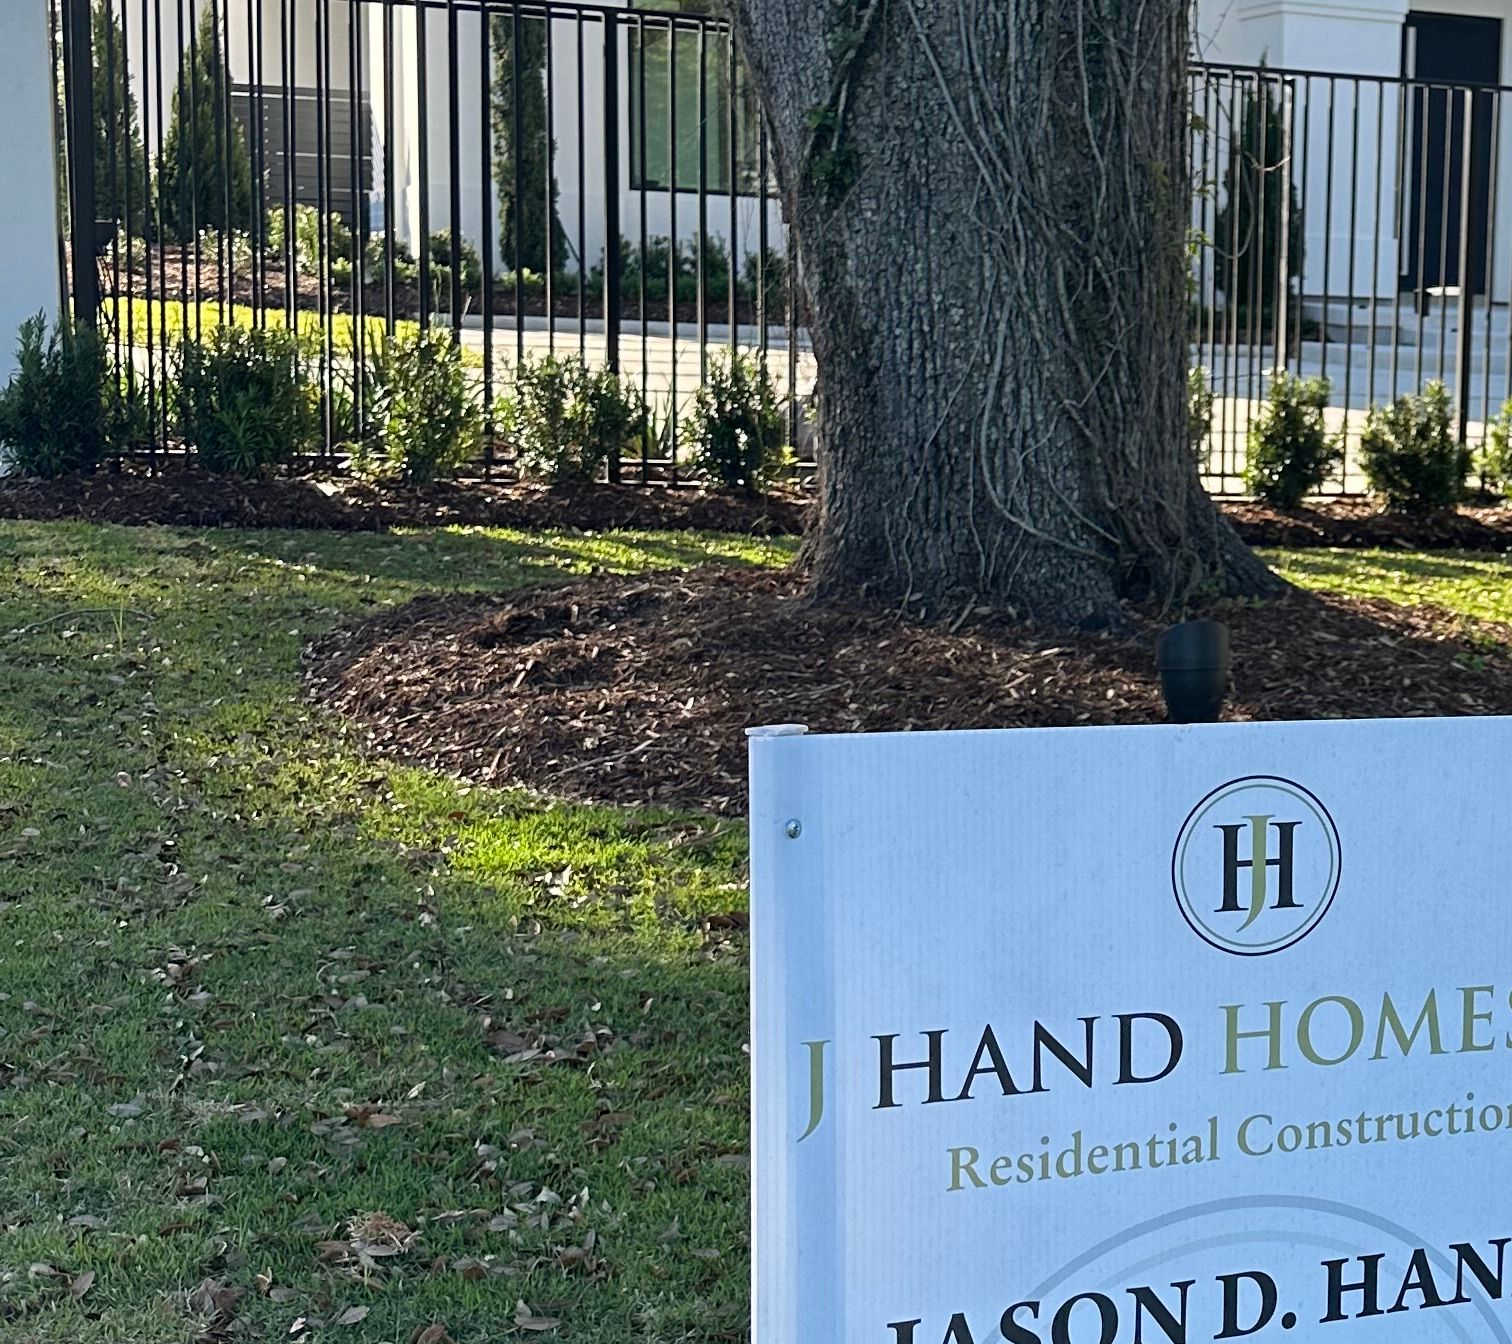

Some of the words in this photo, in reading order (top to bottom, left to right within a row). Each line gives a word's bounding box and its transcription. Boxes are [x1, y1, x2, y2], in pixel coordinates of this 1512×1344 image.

[798, 1039, 832, 1142] J
[871, 1012, 1184, 1109] HAND
[946, 1116, 1220, 1192] Residential
[1213, 1270, 1297, 1341] D.
